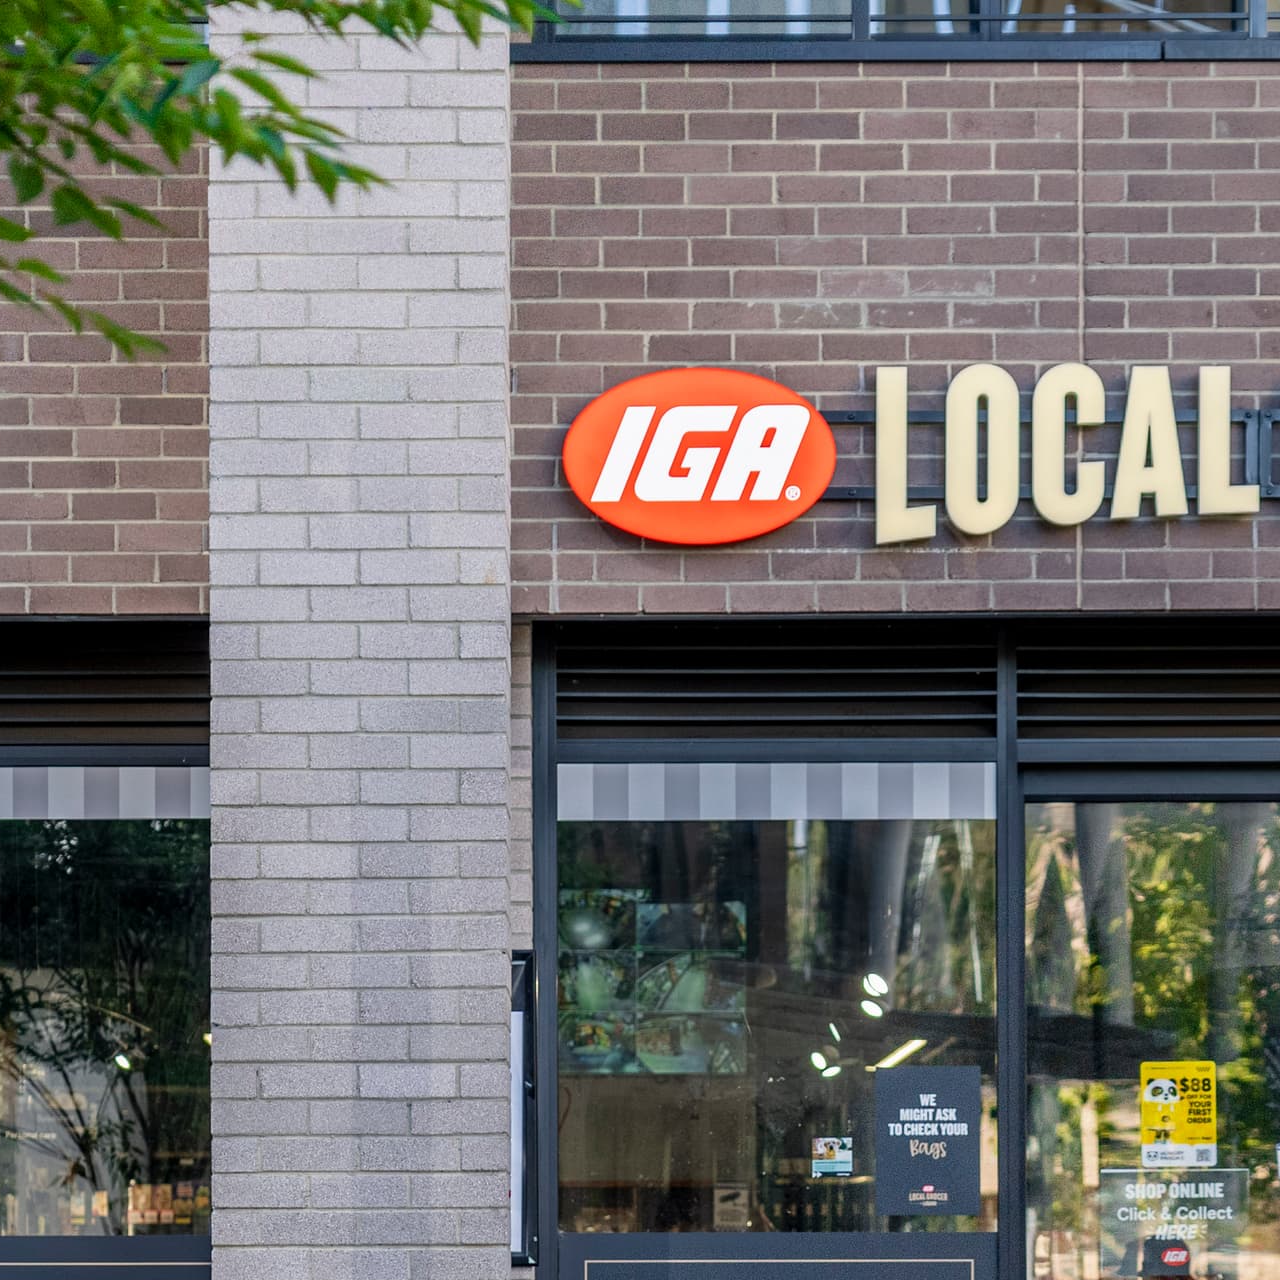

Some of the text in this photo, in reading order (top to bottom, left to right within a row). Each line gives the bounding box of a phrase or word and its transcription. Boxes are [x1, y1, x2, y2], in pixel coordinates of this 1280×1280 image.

[590, 403, 811, 502] IGA
[874, 362, 1261, 545] LOCAL
[1180, 1077, 1212, 1093] $88
[920, 1093, 937, 1106] WE
[899, 1108, 957, 1121] MIGHT ASK
[888, 1123, 969, 1136] TO CHECK YOUR
[909, 1139, 947, 1159] Bags
[1125, 1183, 1224, 1200] SHOP ONLINE
[1117, 1206, 1233, 1222] Click & Collect
[1155, 1224, 1199, 1241] HERE
